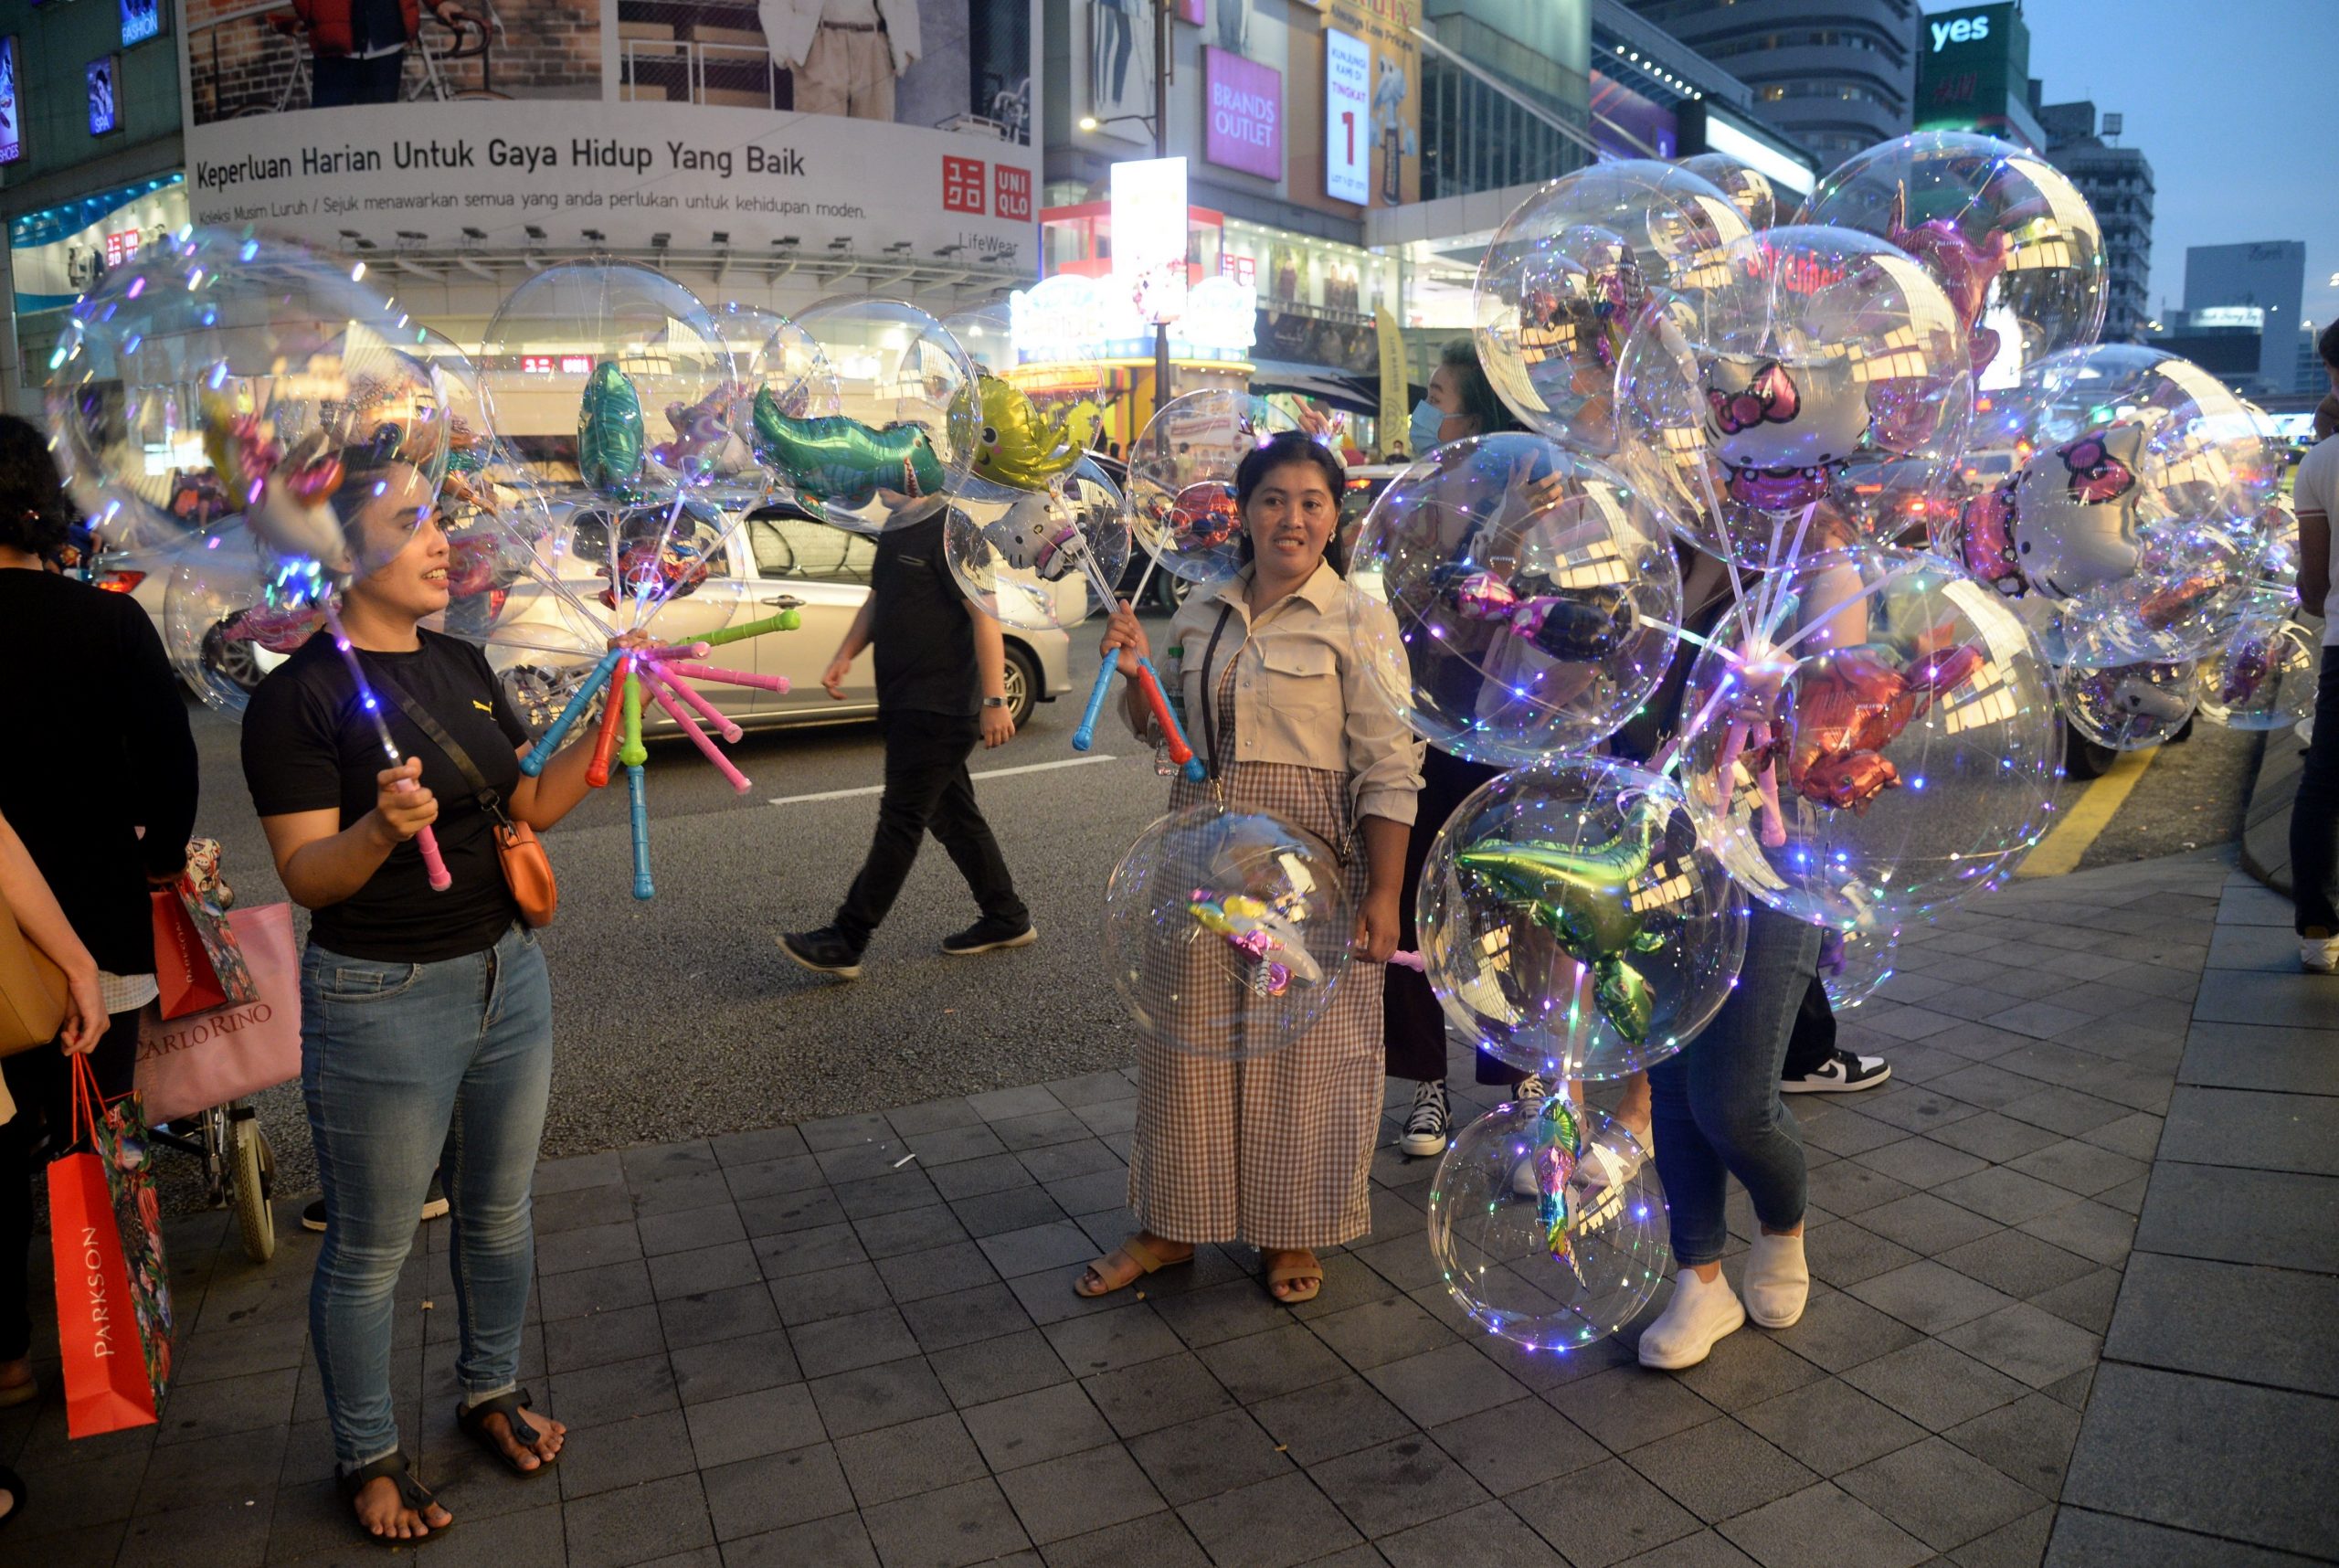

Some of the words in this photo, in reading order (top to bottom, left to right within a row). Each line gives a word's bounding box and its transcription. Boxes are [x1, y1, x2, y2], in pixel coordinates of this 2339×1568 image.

[122, 15, 158, 44] FASHION
[1931, 16, 1989, 53] yes
[1213, 81, 1275, 123] BRANDS
[95, 115, 110, 133] SPA
[1215, 111, 1273, 147] OUTLET
[1341, 111, 1354, 166] 1
[196, 154, 291, 193] Keperluan
[302, 143, 381, 175] Harian
[394, 139, 474, 169] Untuk
[489, 138, 556, 174] Gaya
[572, 138, 652, 175] Hidup
[667, 141, 732, 178] Yang
[746, 145, 805, 176] Baik
[999, 171, 1025, 194] UNI
[198, 209, 230, 225] Koleksi
[234, 205, 268, 220] Musim
[271, 199, 308, 217] Luruh
[313, 198, 319, 214] /
[323, 196, 359, 216] Sejuk
[365, 192, 459, 210] menawarkan
[464, 194, 515, 207] semua
[521, 194, 559, 210] yang
[566, 190, 603, 207] anda
[609, 191, 679, 209] perlukan
[685, 194, 730, 210] untuk
[736, 195, 810, 217] kehidupan
[816, 202, 867, 219] moden.
[1000, 194, 1028, 216] QLO
[959, 231, 1019, 253] LifeWear
[81, 1227, 115, 1358] PARKSON
